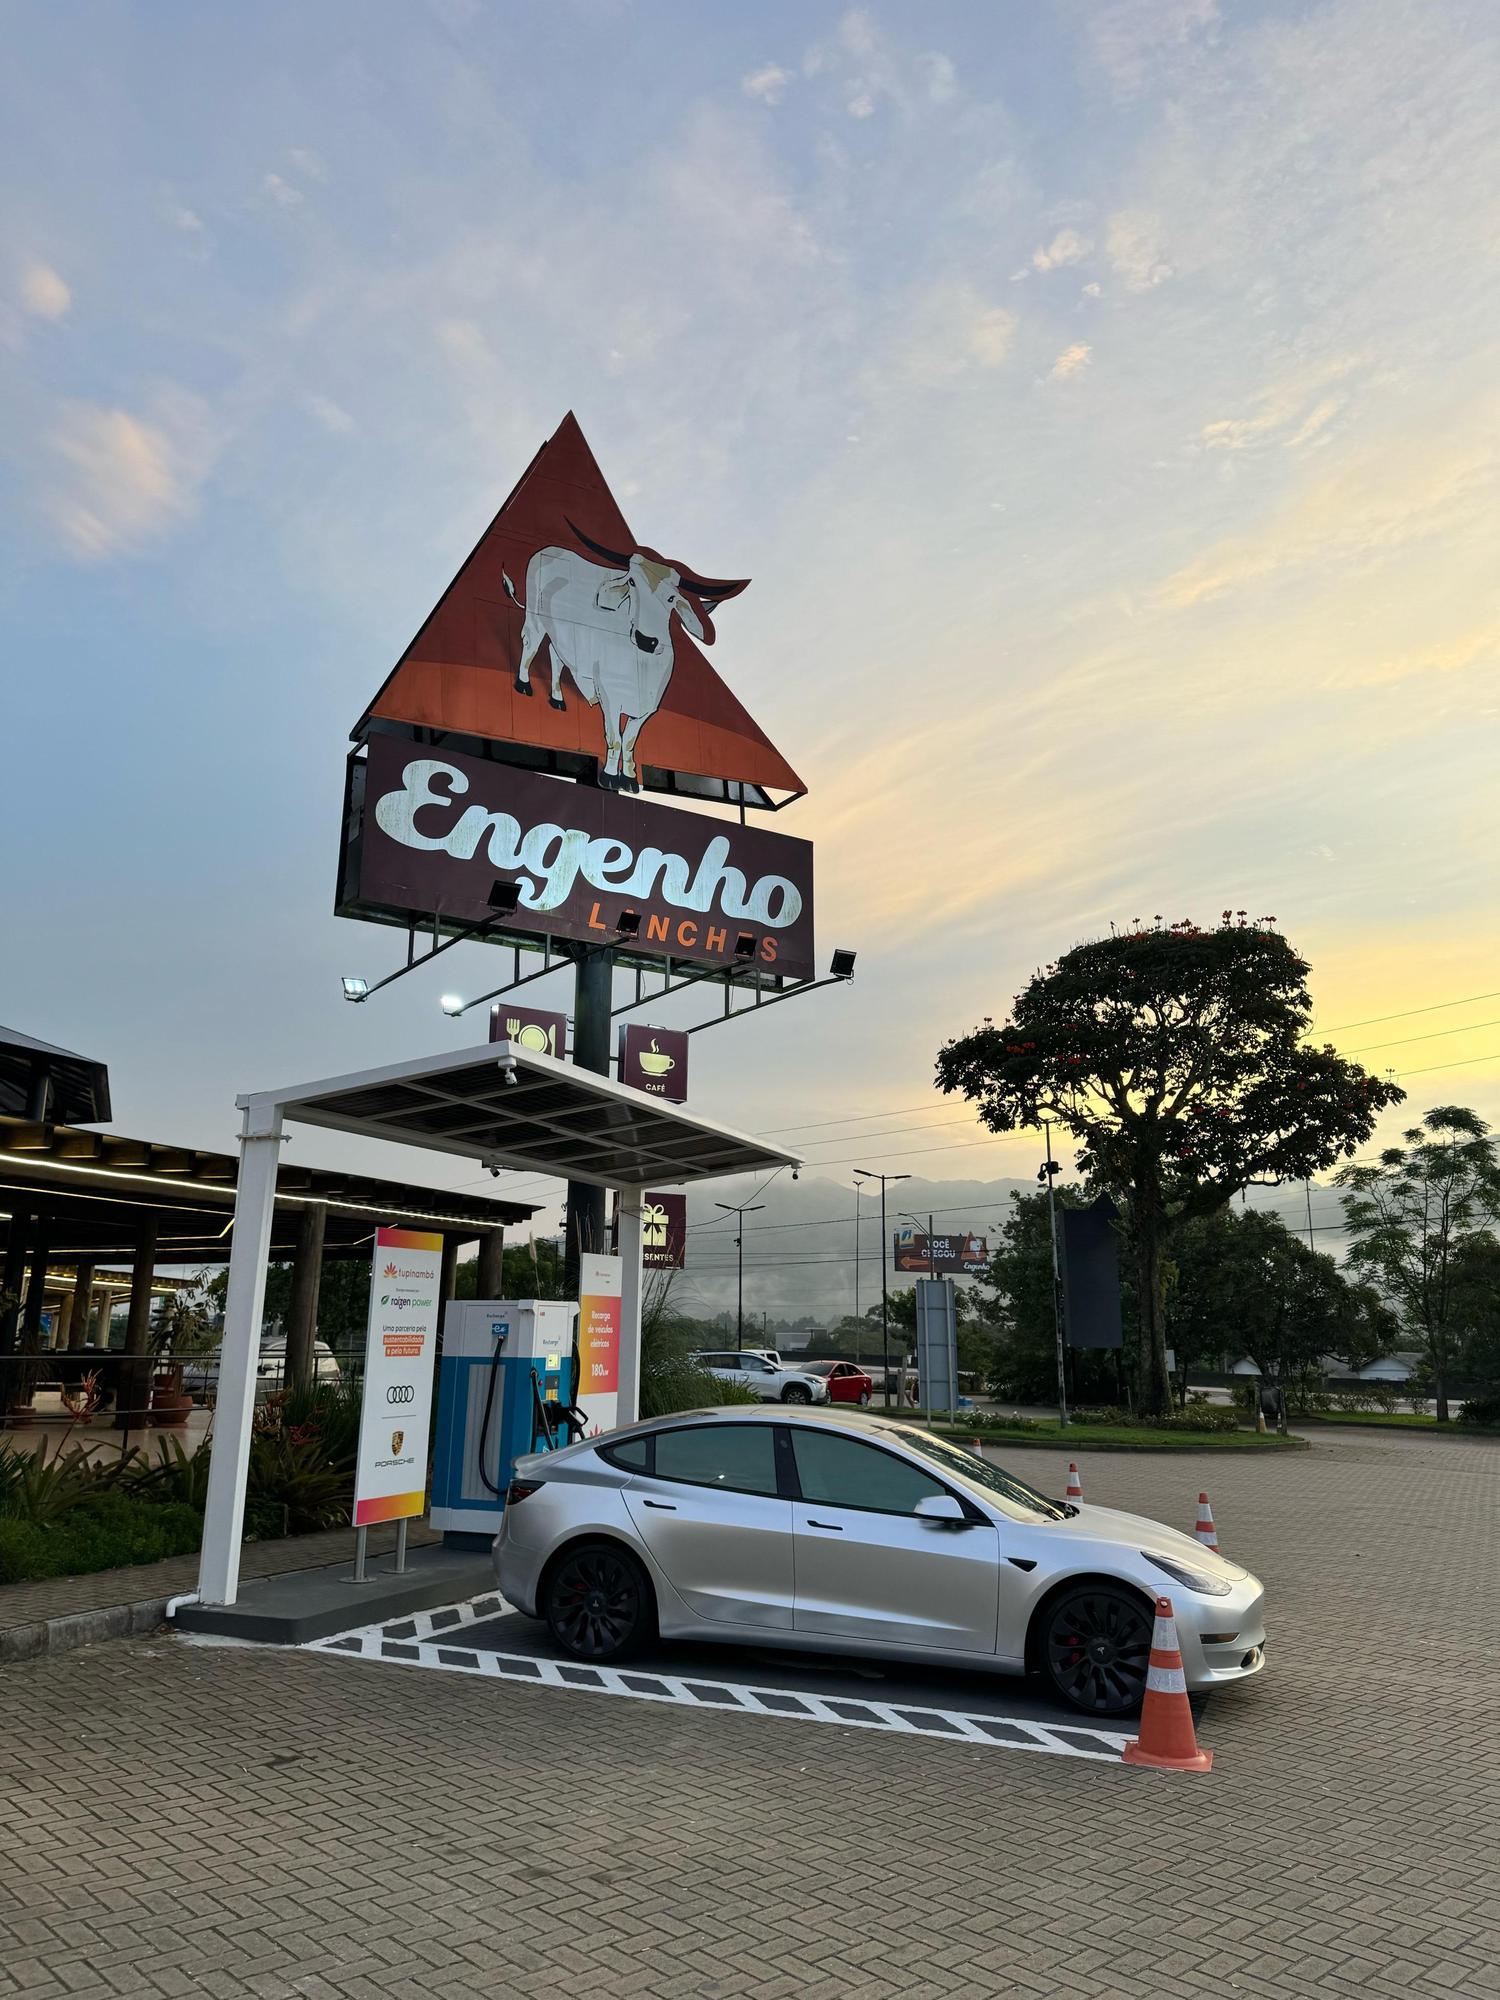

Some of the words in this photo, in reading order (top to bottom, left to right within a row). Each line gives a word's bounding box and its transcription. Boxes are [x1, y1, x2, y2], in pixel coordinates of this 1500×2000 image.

[375, 760, 802, 928] Engenho
[588, 903, 778, 962] LNCHS
[645, 1083, 666, 1093] CAFÉ
[412, 1298, 433, 1308] power
[592, 1311, 610, 1321] Recarga
[375, 1457, 415, 1468] PORSCHE
